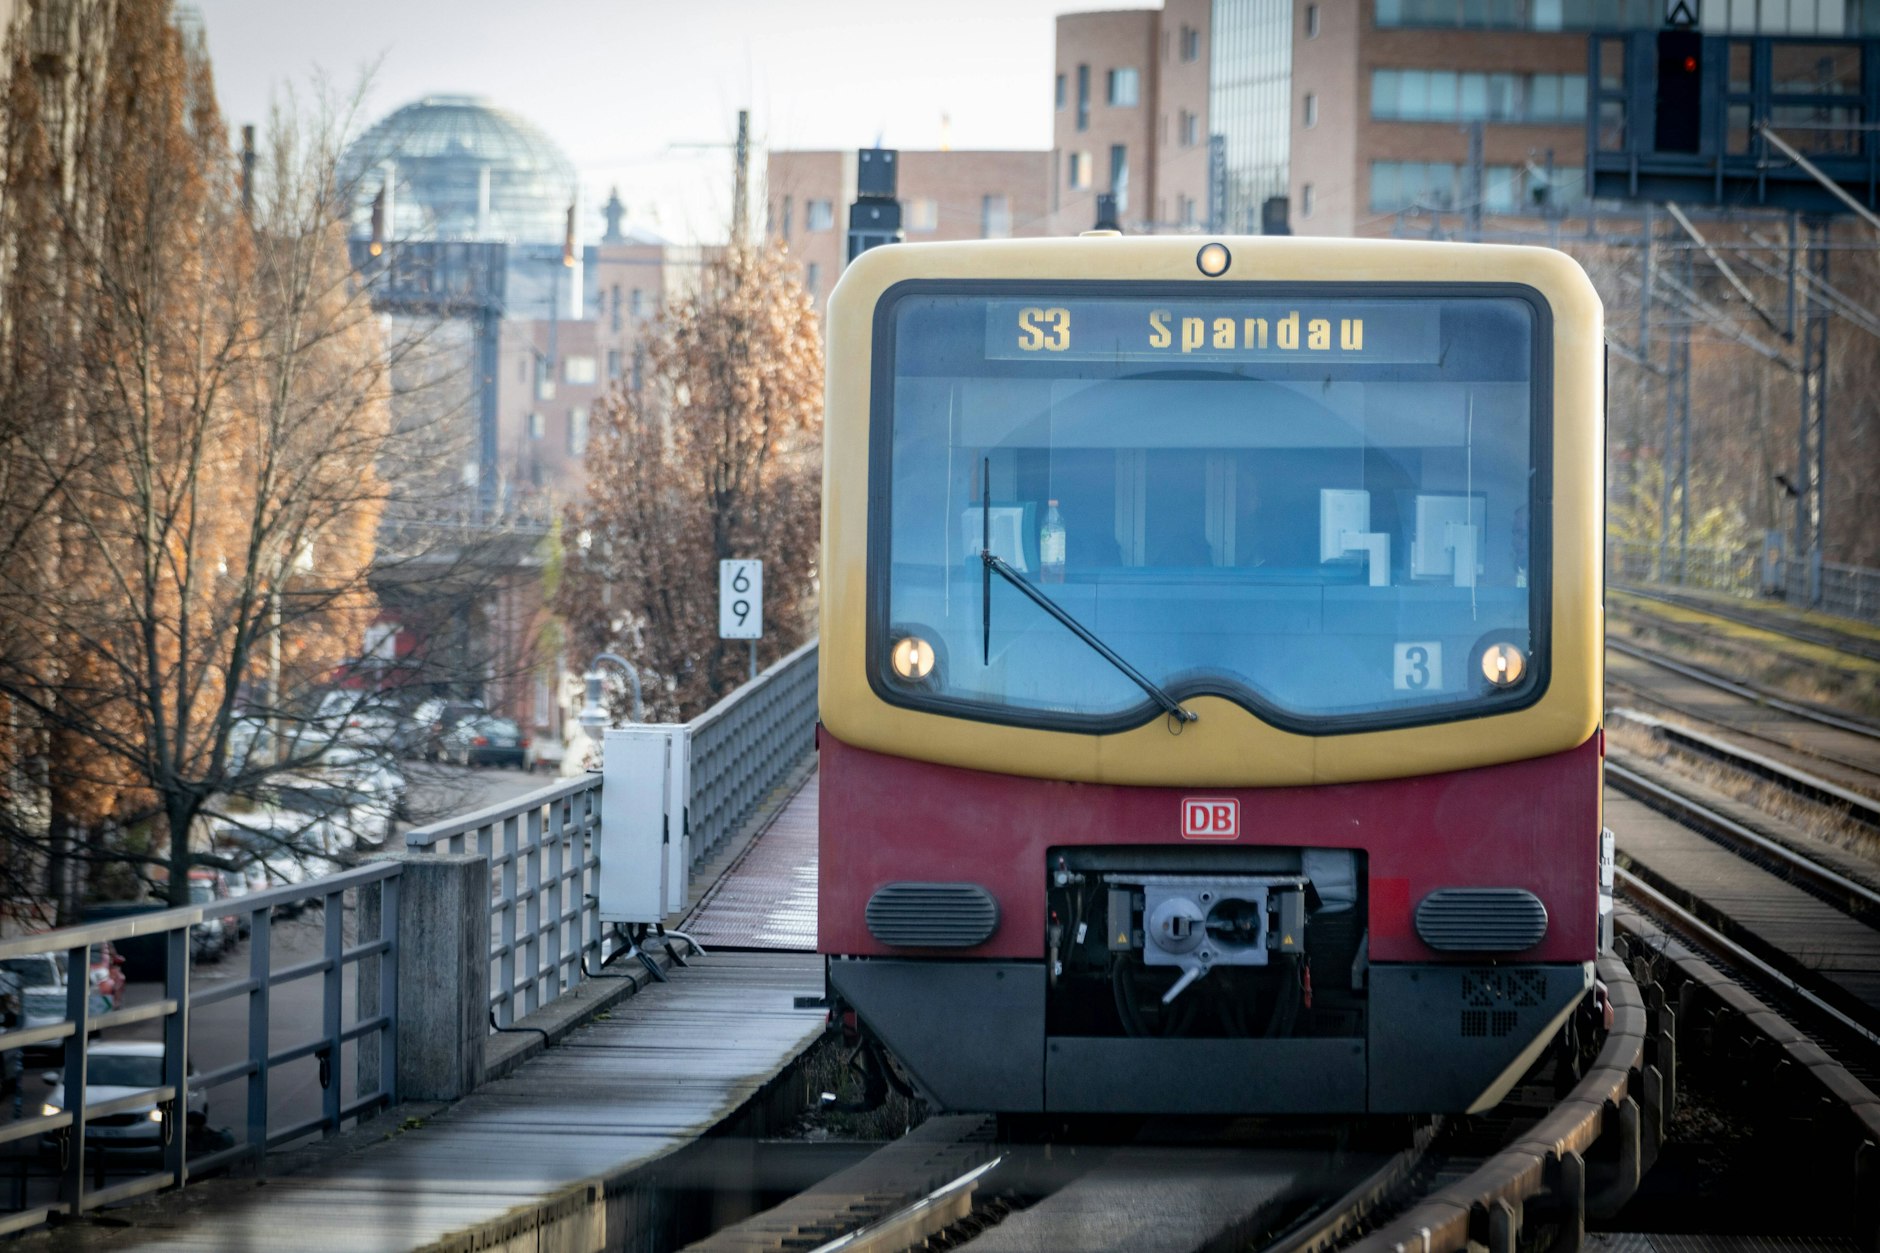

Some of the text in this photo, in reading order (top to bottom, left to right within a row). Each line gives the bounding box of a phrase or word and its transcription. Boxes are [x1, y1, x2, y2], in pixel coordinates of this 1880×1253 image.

[1018, 308, 1363, 353] S3 Spandau
[733, 566, 750, 593] 6
[733, 600, 750, 627] 9
[1405, 646, 1431, 691] 3
[1190, 805, 1232, 832] DB
